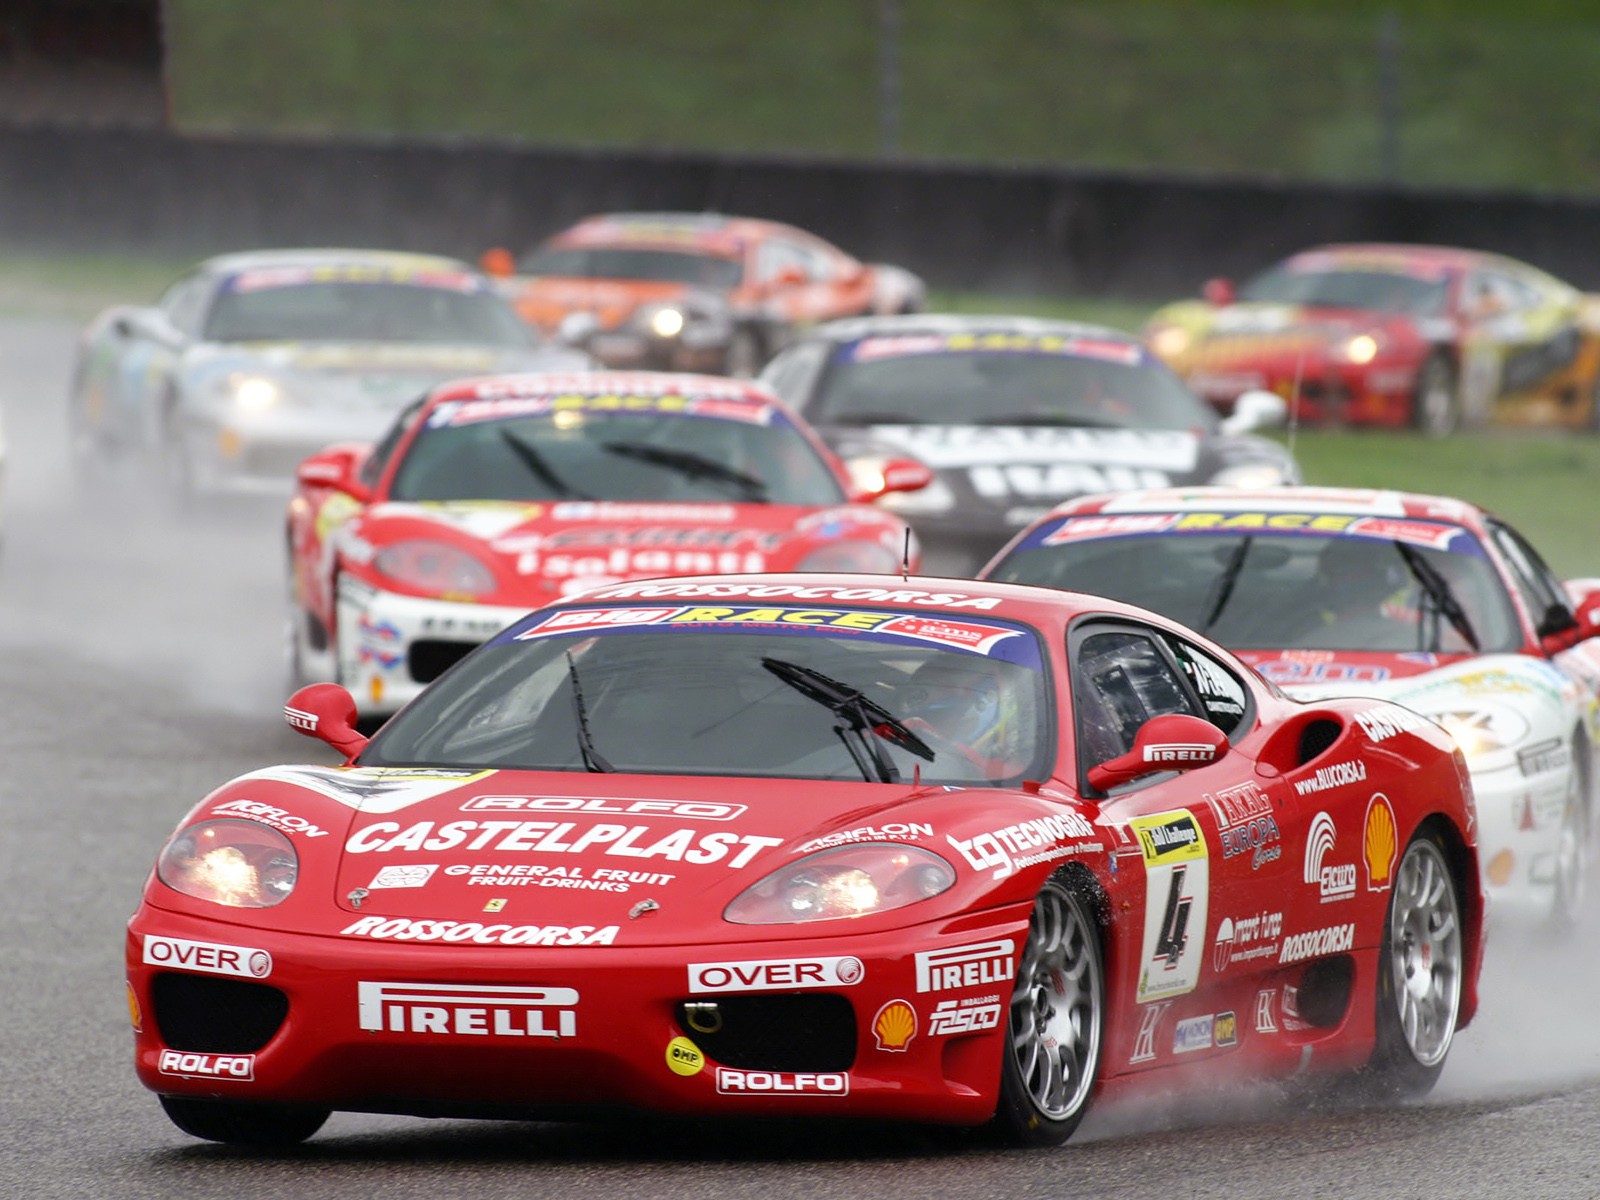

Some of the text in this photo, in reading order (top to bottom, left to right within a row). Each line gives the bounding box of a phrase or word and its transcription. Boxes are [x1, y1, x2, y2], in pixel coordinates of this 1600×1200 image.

[1173, 512, 1355, 530] RACE
[593, 583, 1002, 611] ROSSOCORSA
[668, 607, 896, 629] RACE
[1143, 743, 1216, 763] PIRELLI
[211, 799, 329, 838] AGIFLON
[472, 797, 732, 817] ROLFO
[345, 820, 783, 870] CASTELPLAST
[789, 822, 934, 854] AGIFLON
[993, 812, 1096, 854] TECNOGRAF
[1218, 814, 1281, 859] EUROPA
[443, 863, 675, 886] GENERAL FRUIT
[466, 875, 631, 893] FRUIT-DRINKS
[341, 916, 619, 946] ROSSOCORSA
[1151, 865, 1193, 970] 4
[150, 941, 240, 971] OVER
[1278, 923, 1356, 964] ROSSOCORSA
[699, 963, 825, 987] OVER
[914, 938, 1015, 993] PIRELLI
[358, 981, 580, 1038] PIRELLI
[161, 1052, 250, 1076] ROLFO
[721, 1071, 843, 1091] ROLFO
